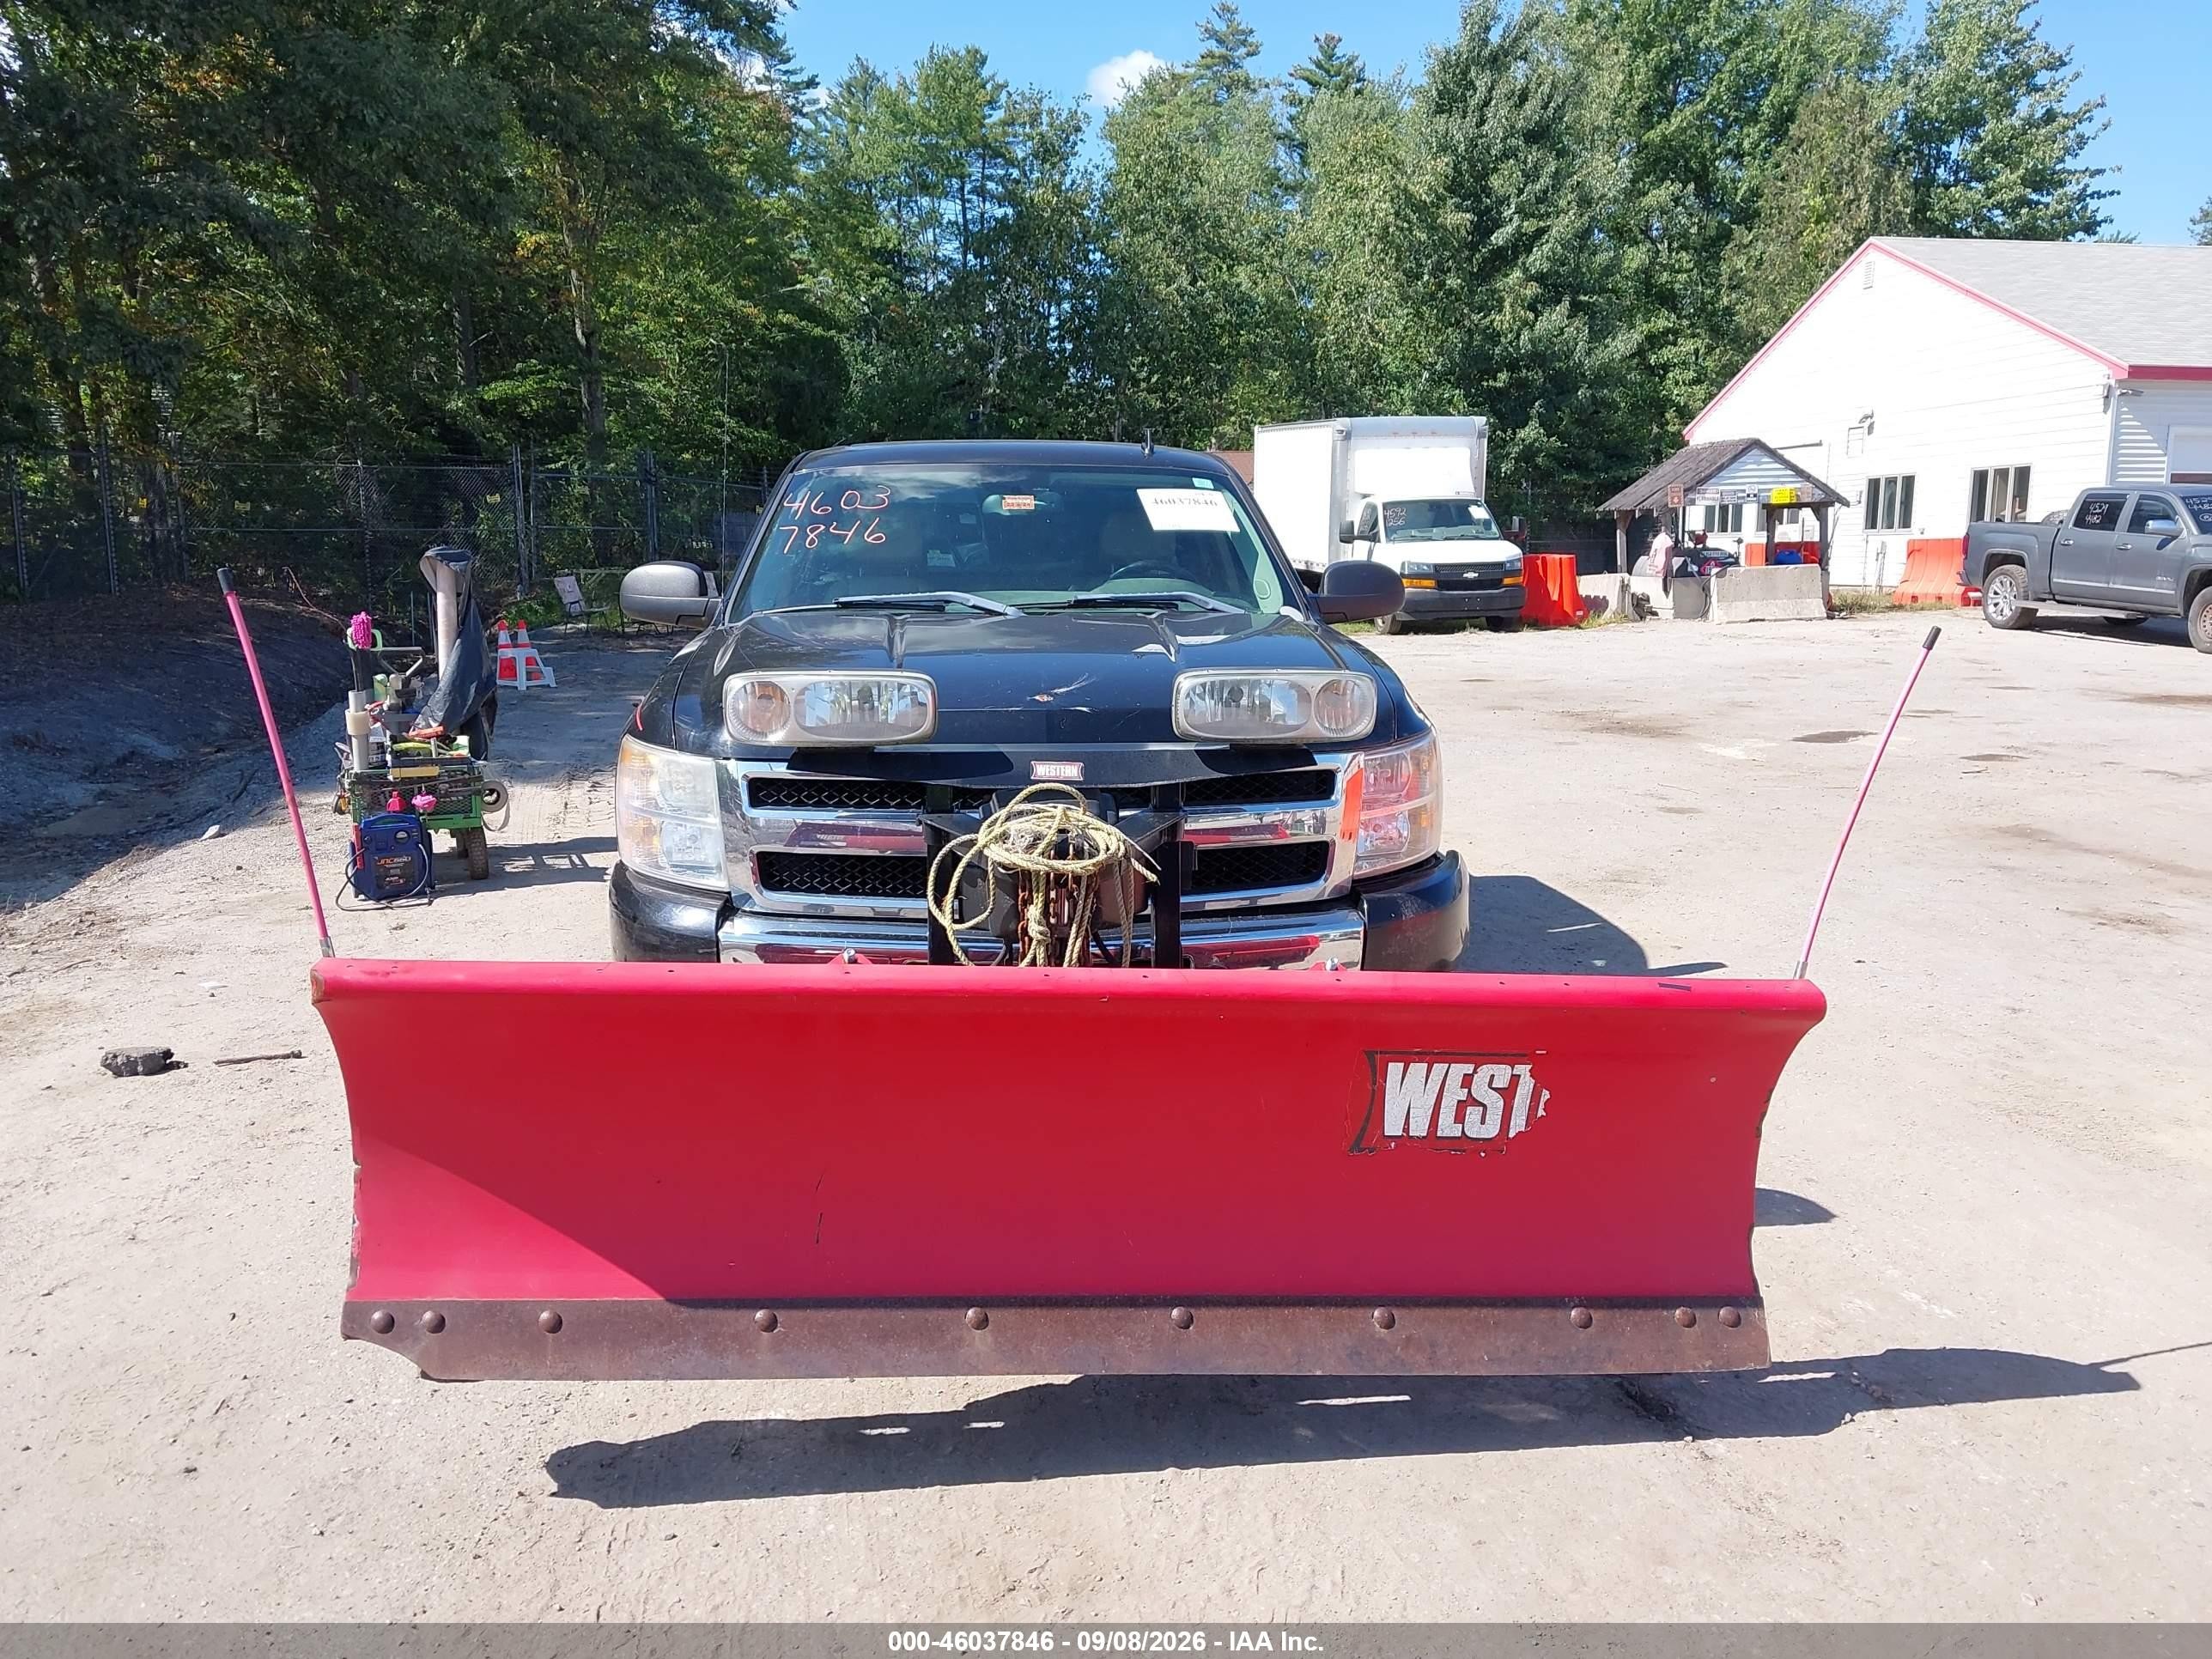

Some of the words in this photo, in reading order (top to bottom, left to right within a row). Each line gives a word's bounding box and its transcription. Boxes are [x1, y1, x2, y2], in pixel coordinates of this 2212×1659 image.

[782, 484, 891, 520] 4603
[1383, 507, 1407, 519] 4592
[779, 517, 886, 555] 7846
[1036, 764, 1079, 777] WESTERN
